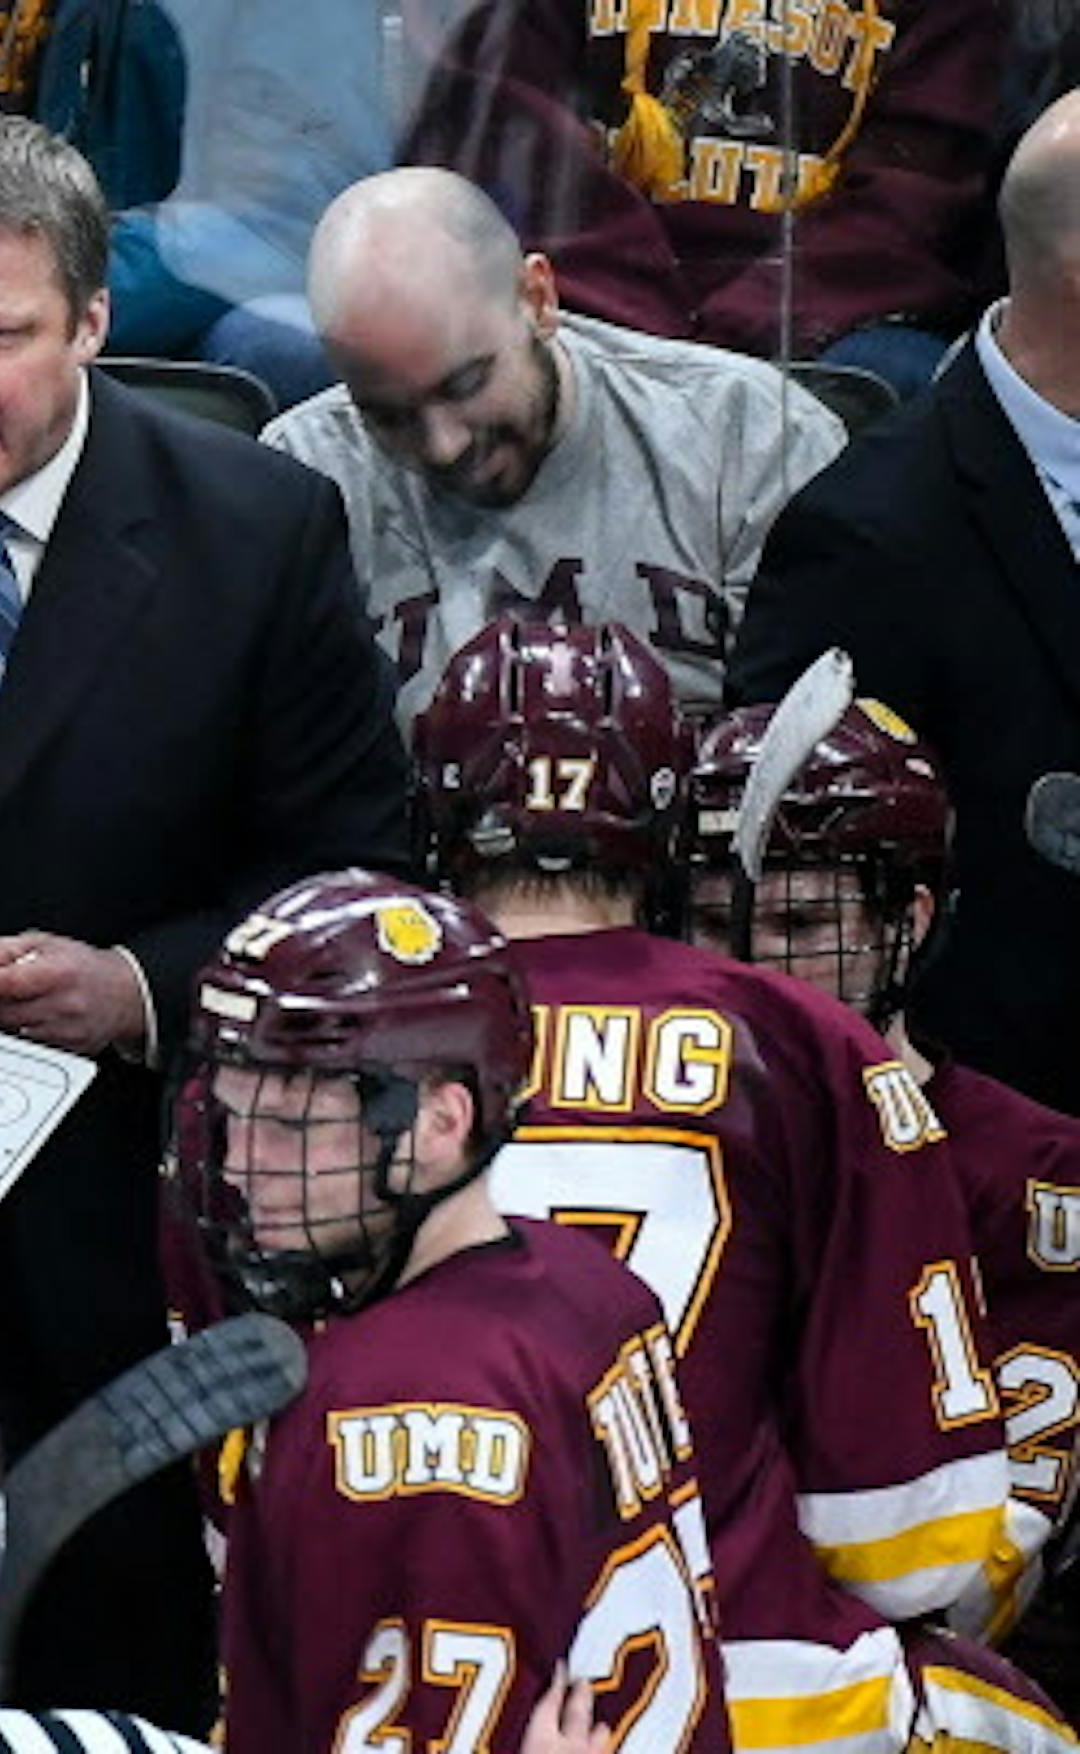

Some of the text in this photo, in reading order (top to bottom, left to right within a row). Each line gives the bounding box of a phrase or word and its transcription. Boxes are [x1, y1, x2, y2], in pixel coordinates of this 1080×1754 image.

[523, 755, 597, 813] 17
[327, 1401, 532, 1507] UMD
[332, 1617, 520, 1754] 27
